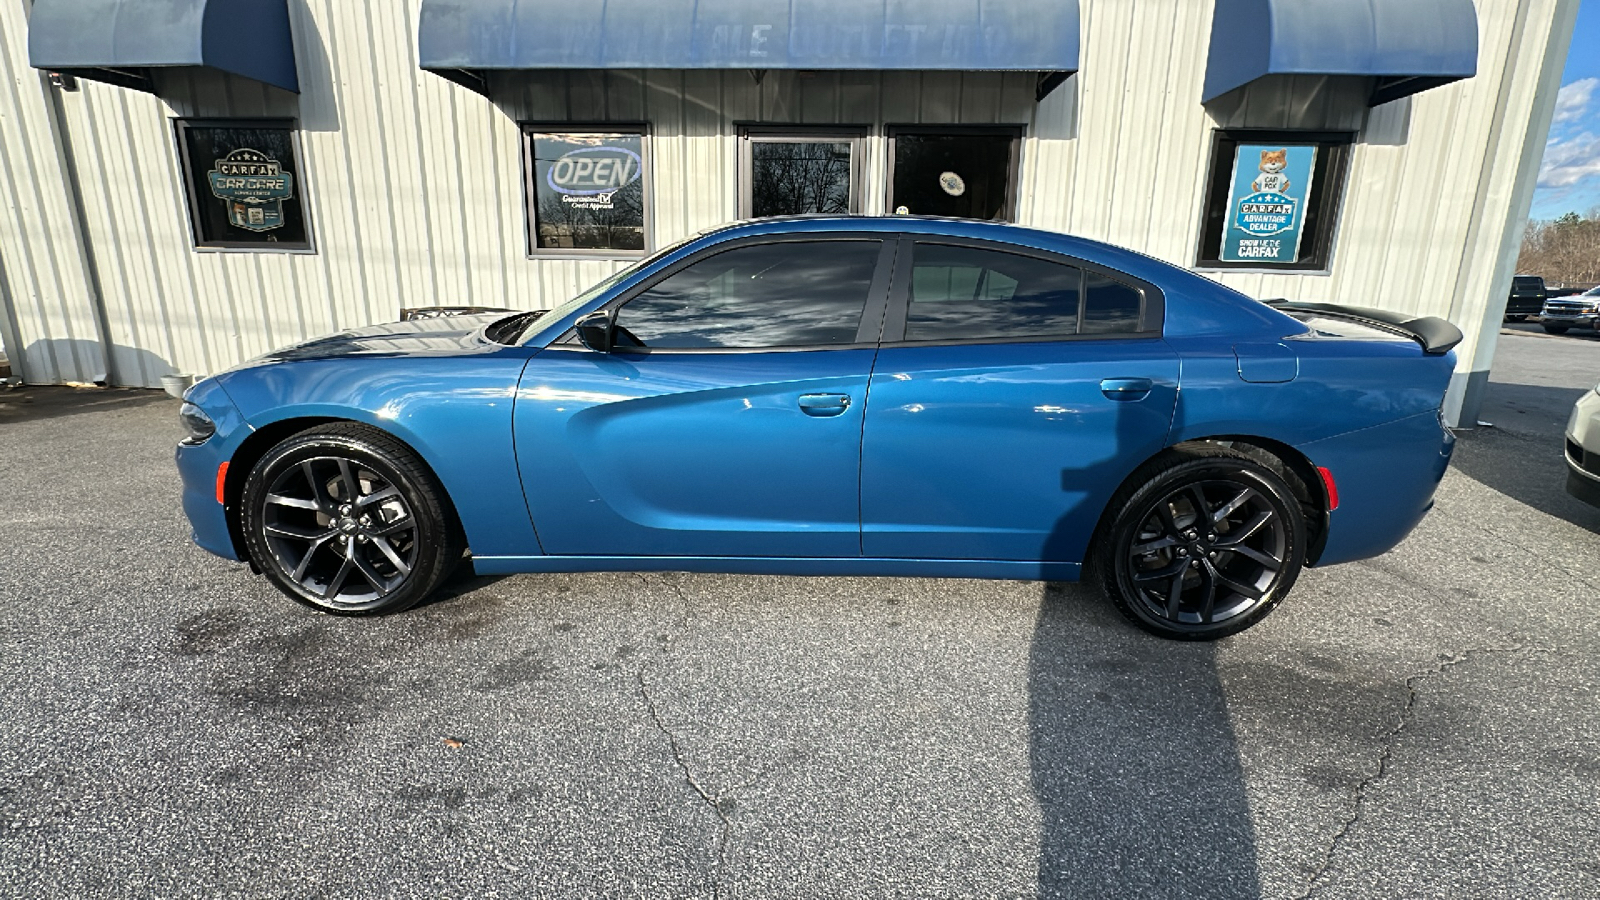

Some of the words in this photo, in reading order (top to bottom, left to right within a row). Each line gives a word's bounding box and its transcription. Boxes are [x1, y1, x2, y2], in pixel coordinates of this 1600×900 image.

[221, 164, 278, 176] CARFAX
[553, 155, 633, 187] OPEN
[216, 177, 246, 189] CAR
[247, 178, 285, 190] CARE
[1242, 204, 1291, 213] CARFAX
[1243, 214, 1287, 223] ADVANTAGE
[1249, 223, 1278, 231] DEALER
[1239, 239, 1259, 247] SHOW
[1238, 246, 1280, 257] CARFAX
